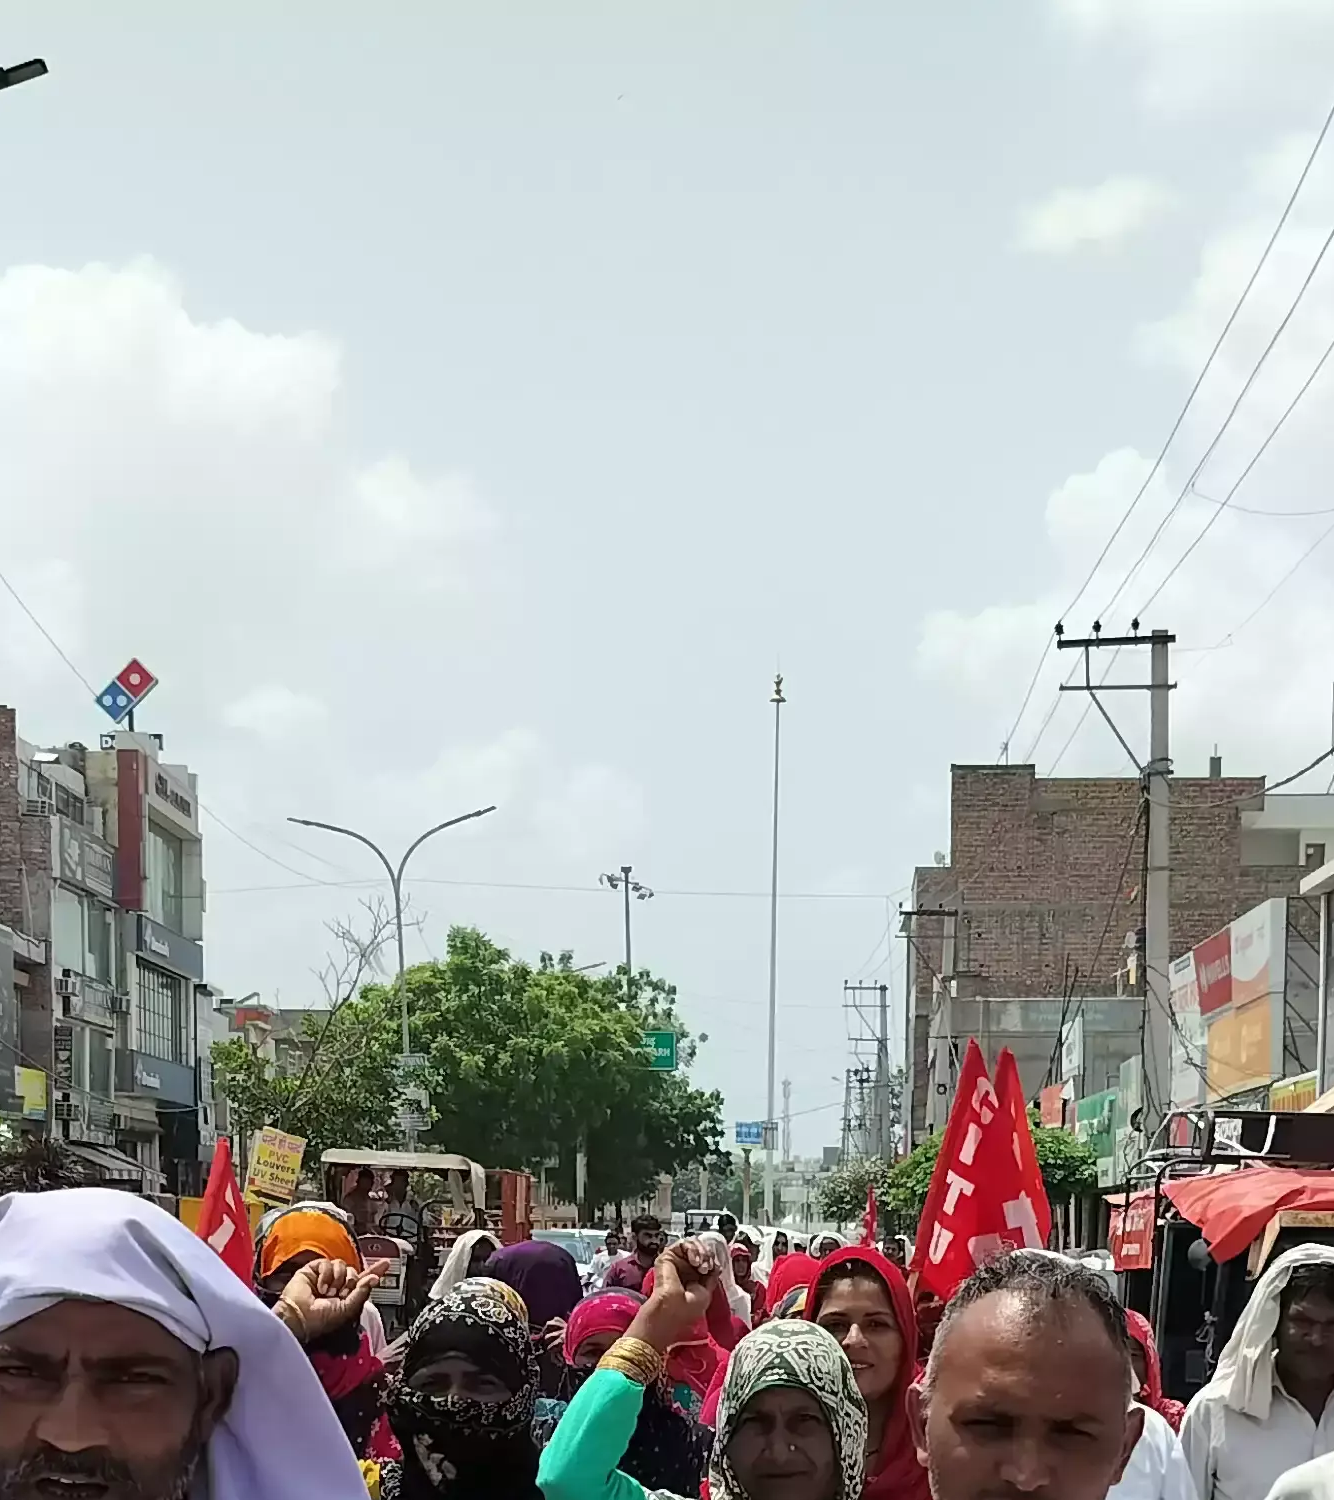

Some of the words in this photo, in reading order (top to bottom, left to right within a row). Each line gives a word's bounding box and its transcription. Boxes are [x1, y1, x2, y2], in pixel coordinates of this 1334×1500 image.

[256, 1156, 296, 1175] Louvers
[268, 1150, 289, 1164] PVC
[253, 1168, 267, 1179] UV
[269, 1173, 295, 1187] Sheet
[928, 1076, 999, 1265] CITU
